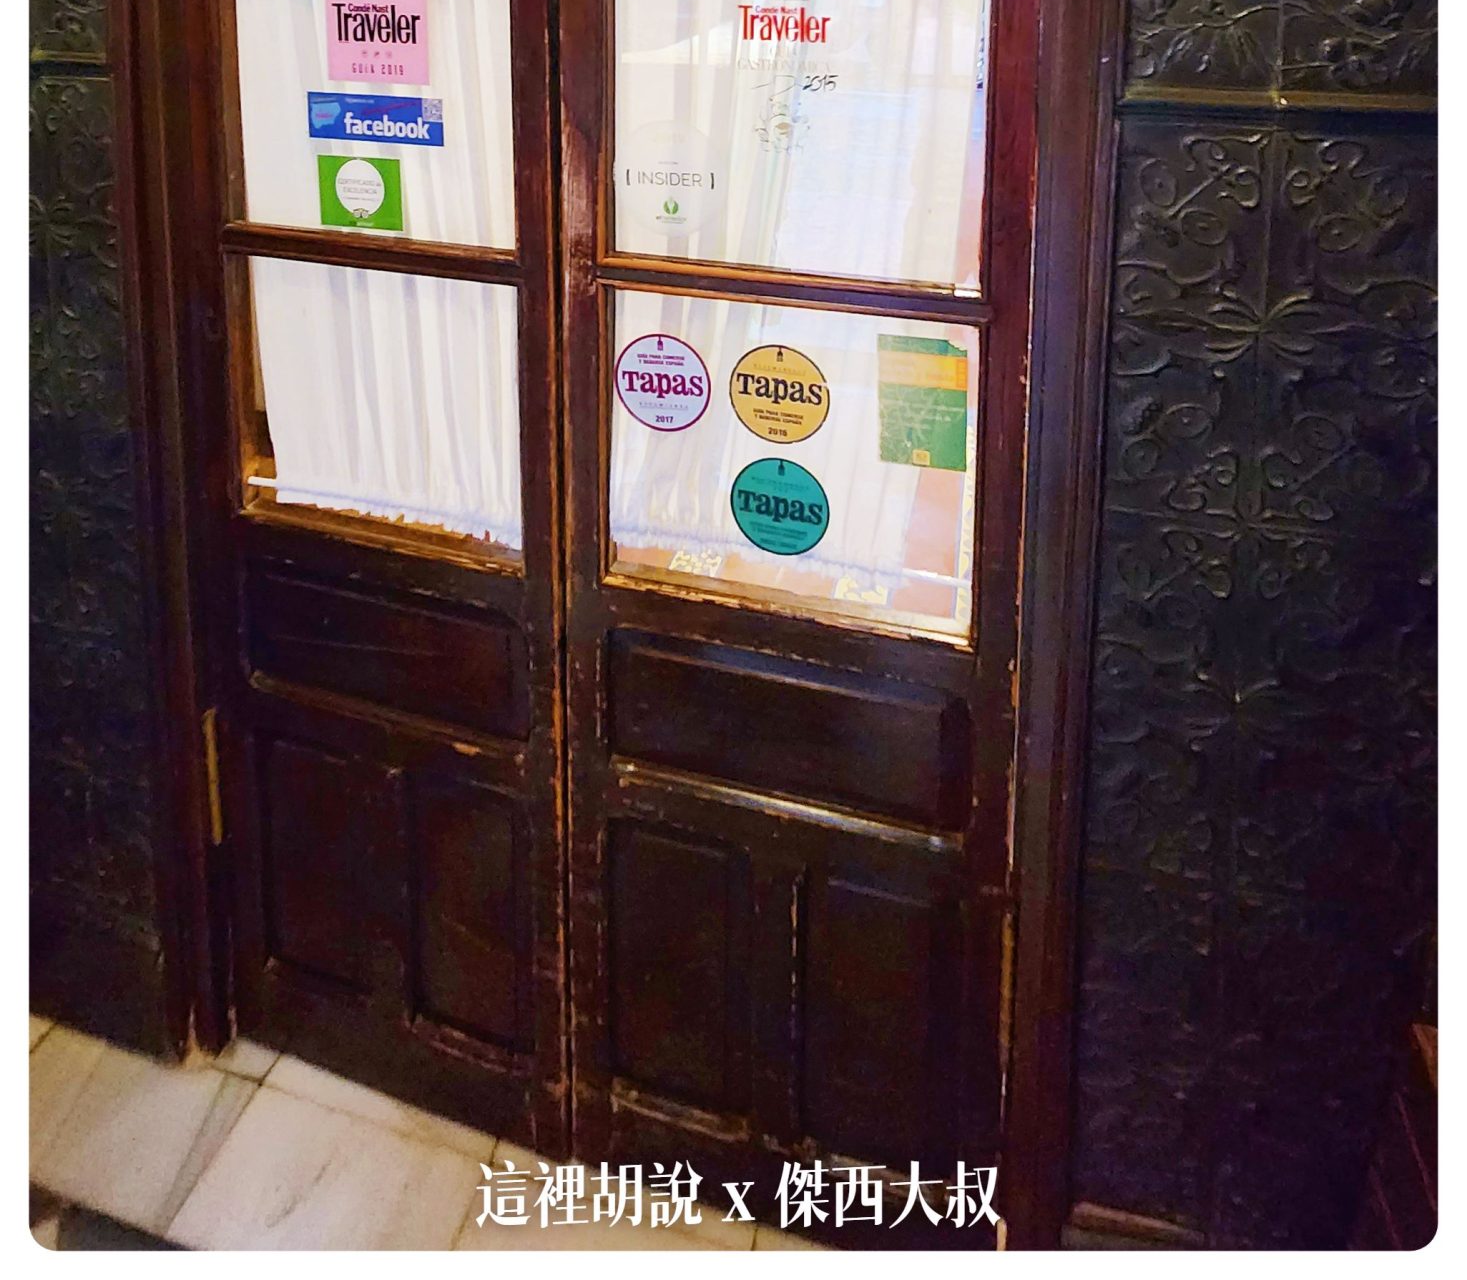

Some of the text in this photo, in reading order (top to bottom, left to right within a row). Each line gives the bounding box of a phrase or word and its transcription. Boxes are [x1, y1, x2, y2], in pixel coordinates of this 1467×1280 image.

[331, 3, 421, 45] Traveler
[738, 4, 832, 44] Traveler
[343, 111, 431, 140] facebook
[637, 171, 703, 188] INSIDER
[621, 370, 704, 399] Tapas
[736, 372, 823, 406] Tapas
[655, 414, 674, 424] 2017
[737, 489, 824, 527] Tapas
